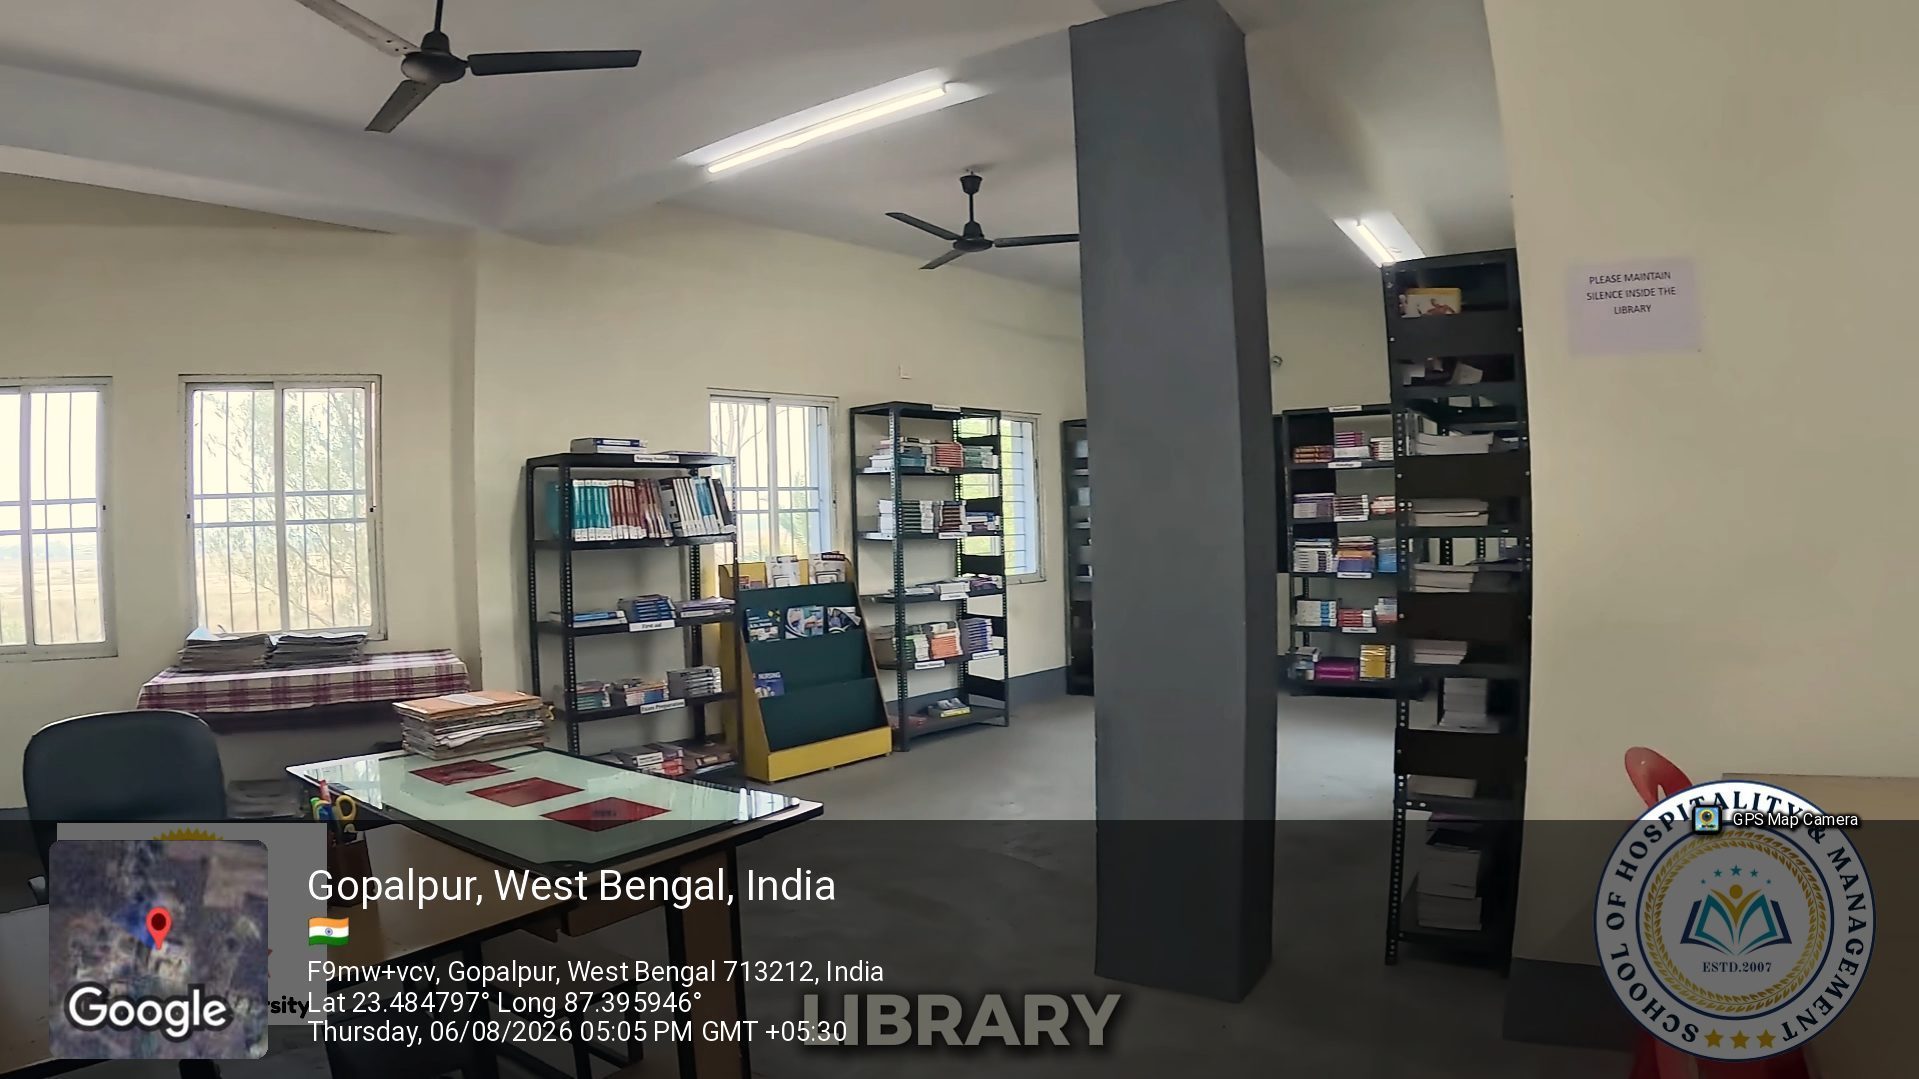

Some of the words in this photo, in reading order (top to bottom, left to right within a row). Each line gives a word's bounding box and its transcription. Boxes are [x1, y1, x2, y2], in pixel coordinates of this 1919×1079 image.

[1588, 274, 1622, 285] PLEASE
[1624, 271, 1671, 282] MAINTAIN
[1586, 290, 1623, 301] SILENCE
[1625, 287, 1656, 298] INSIDE
[1657, 286, 1677, 295] THE
[1613, 304, 1652, 315] LIBRARY
